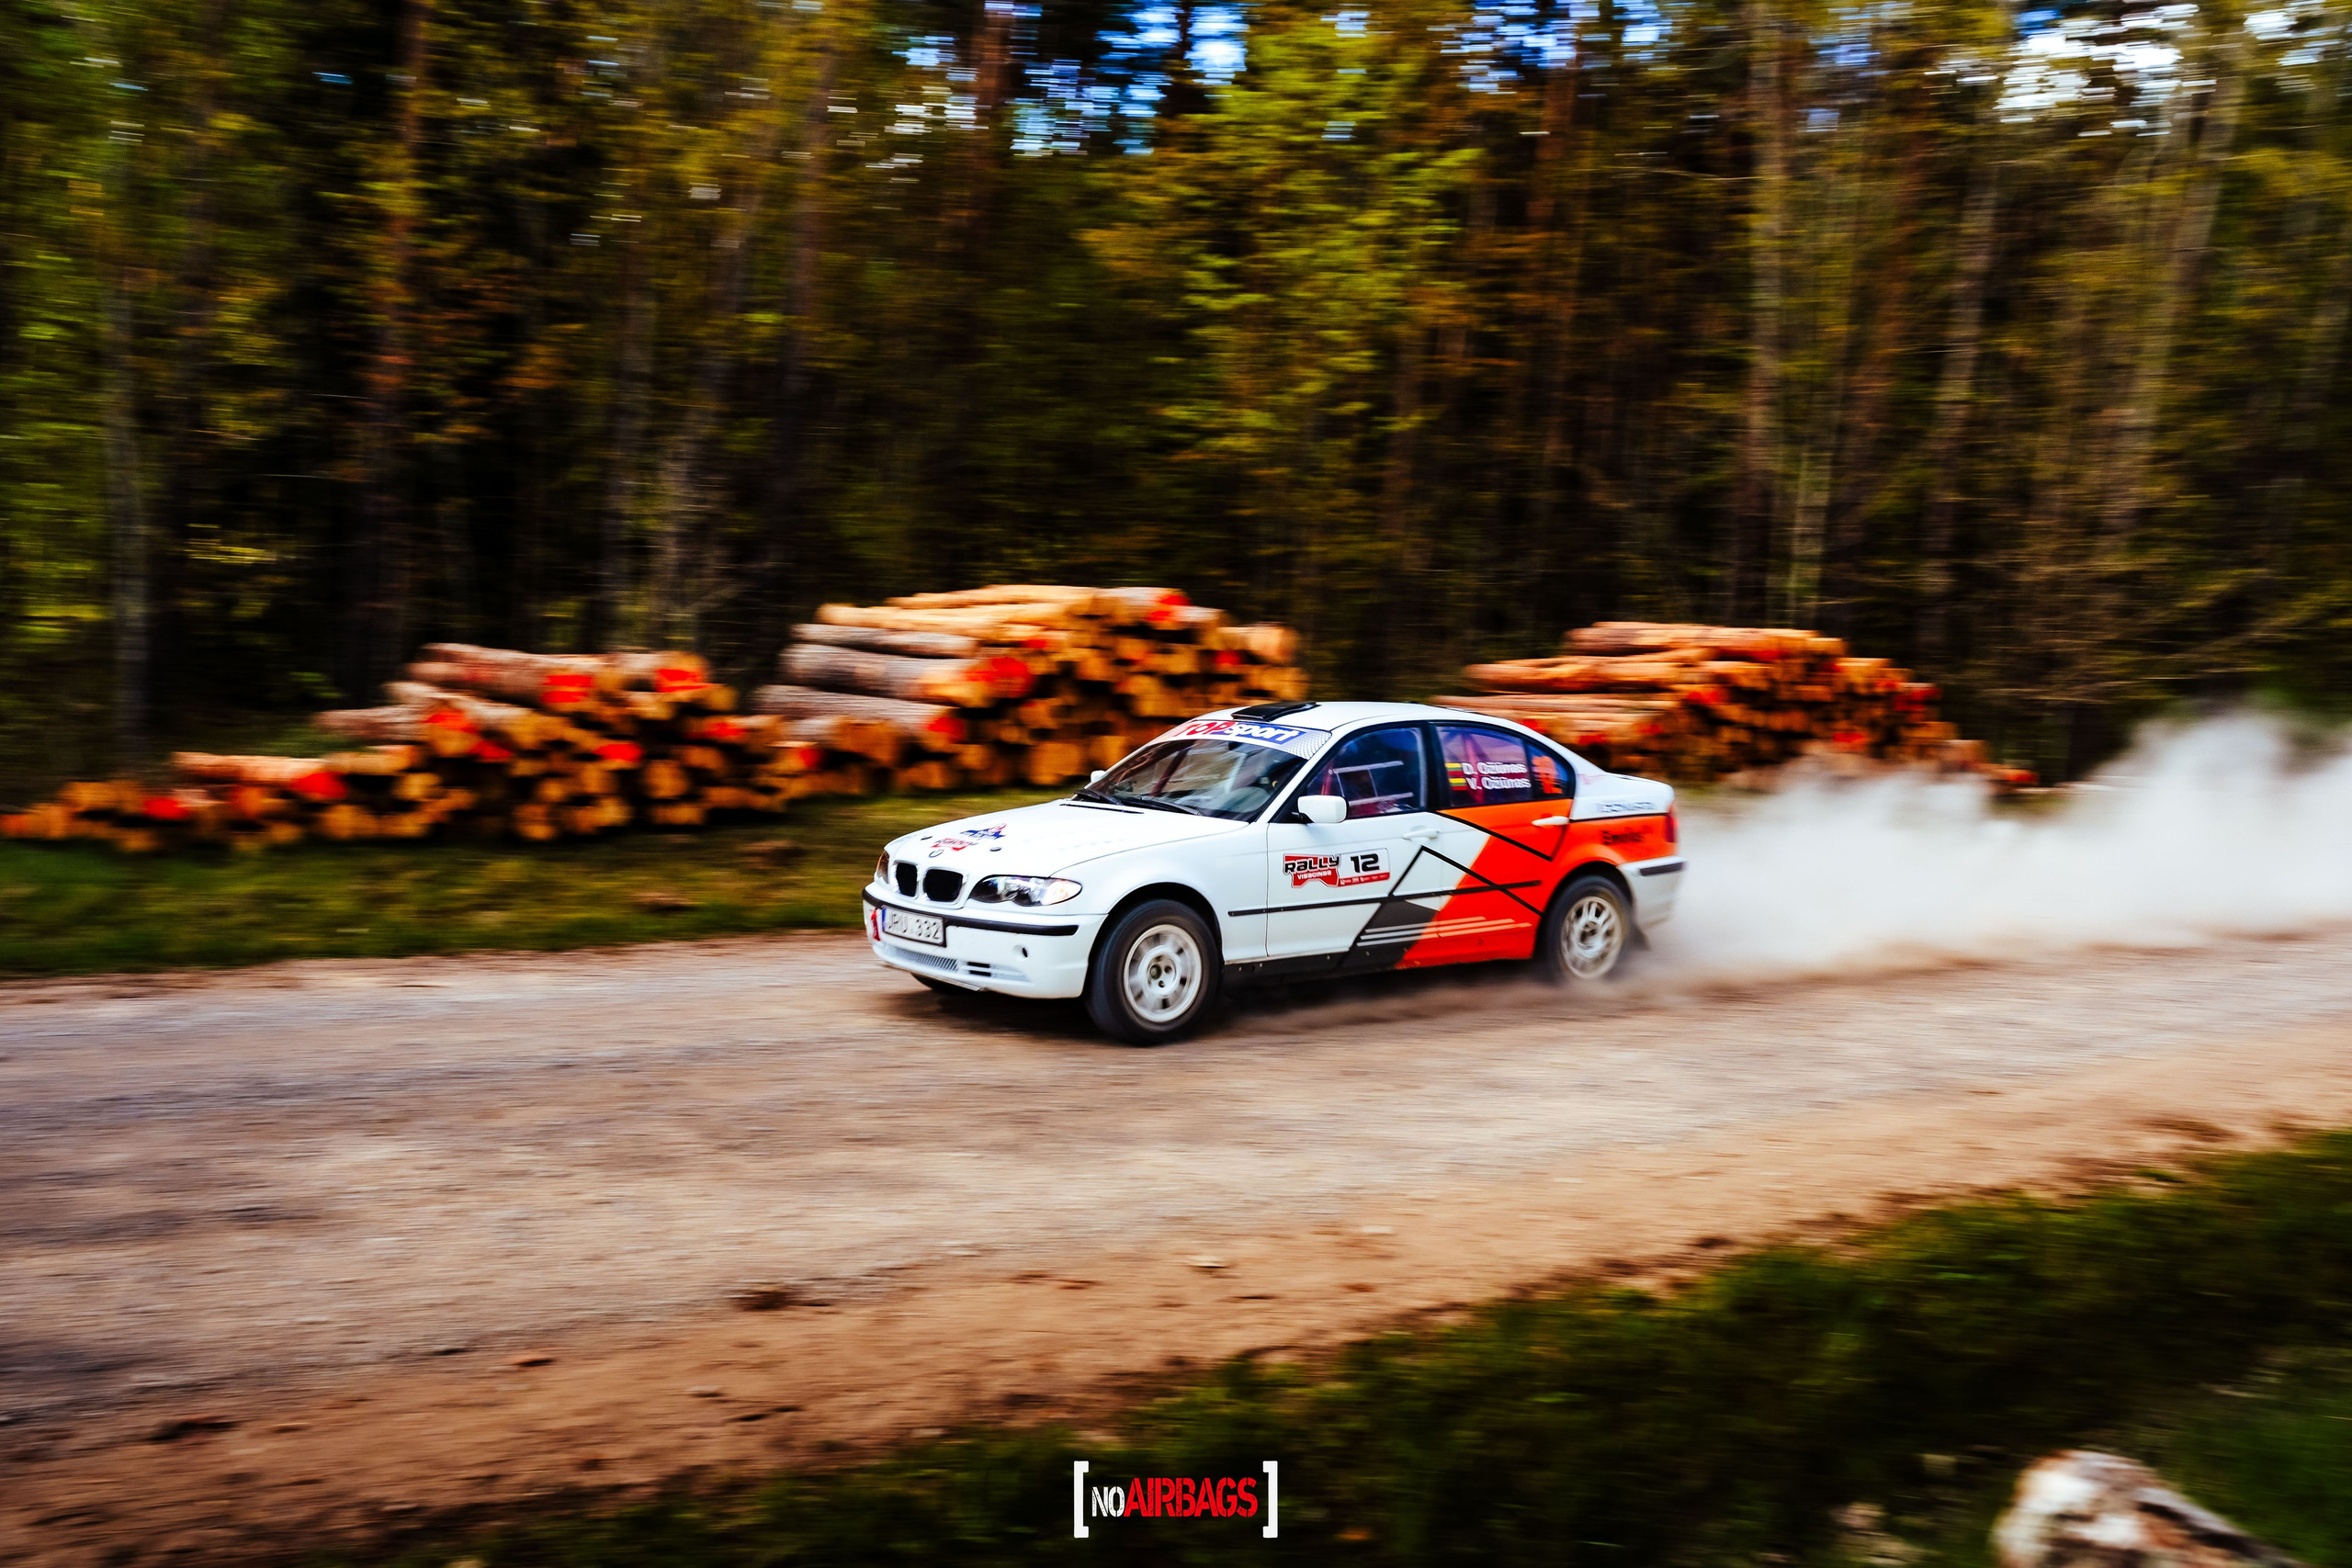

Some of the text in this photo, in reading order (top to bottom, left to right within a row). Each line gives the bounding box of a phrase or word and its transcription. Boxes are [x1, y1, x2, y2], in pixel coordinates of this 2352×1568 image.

[1461, 762, 1477, 774] D.
[1466, 777, 1482, 790] V.
[1350, 853, 1380, 874] 12
[915, 918, 941, 939] 332
